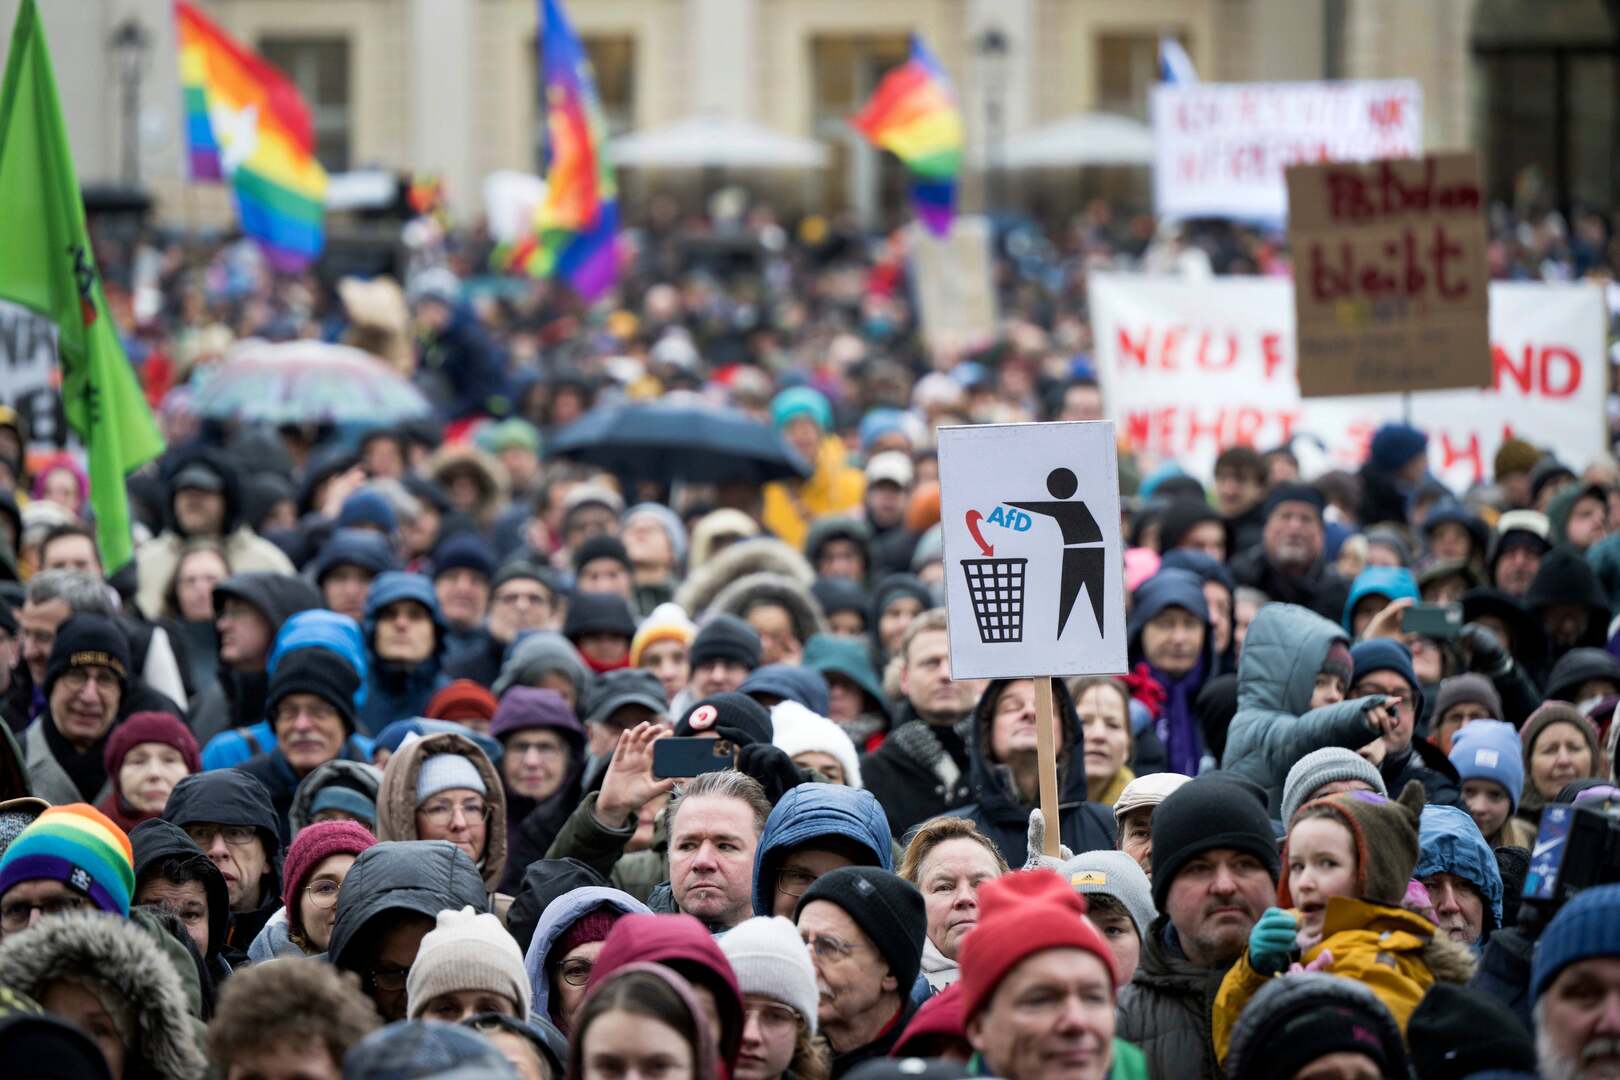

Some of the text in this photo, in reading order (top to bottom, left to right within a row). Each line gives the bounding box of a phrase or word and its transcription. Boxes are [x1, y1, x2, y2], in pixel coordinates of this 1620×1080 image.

[1310, 222, 1469, 302] bleibt
[1116, 324, 1240, 370] NEU
[986, 505, 1033, 533] AfD
